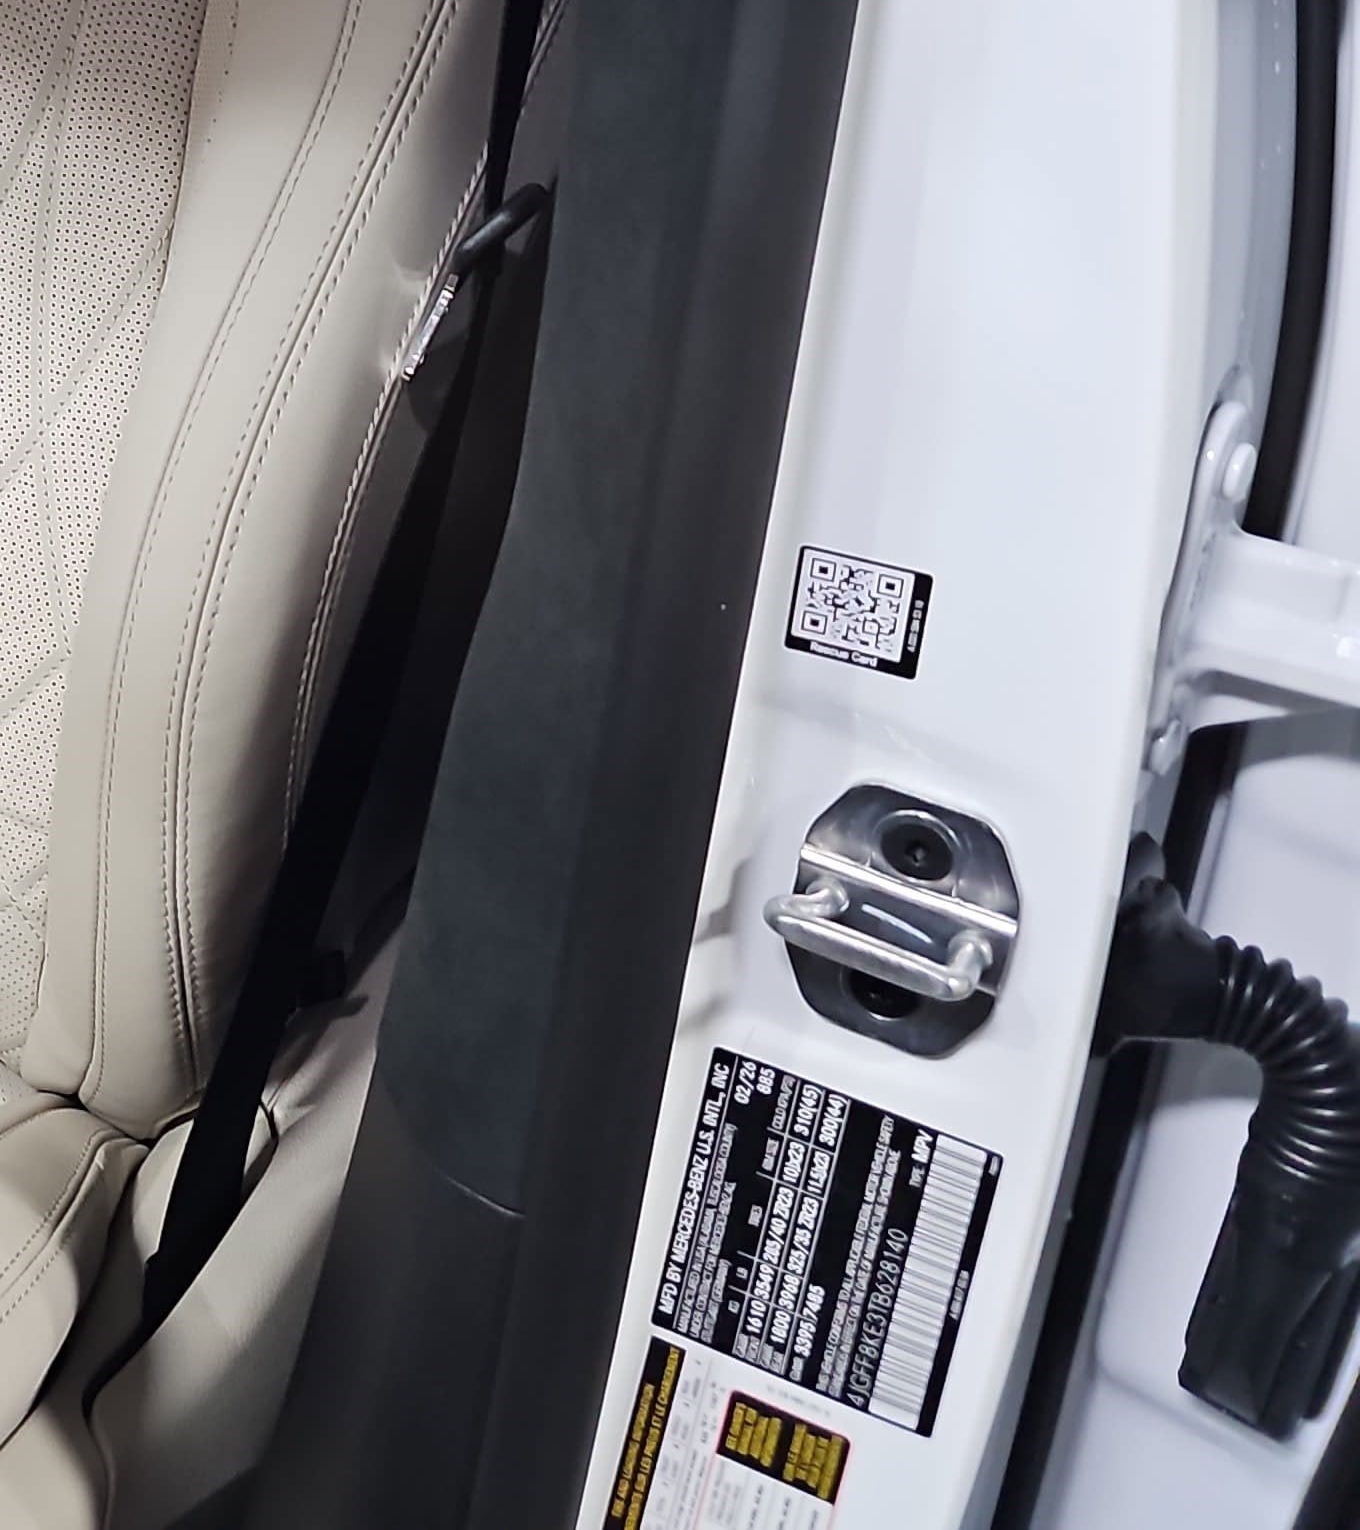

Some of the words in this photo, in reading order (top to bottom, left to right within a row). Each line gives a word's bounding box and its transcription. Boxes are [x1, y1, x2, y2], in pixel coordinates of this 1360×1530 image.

[809, 641, 850, 660] Rescue
[851, 651, 878, 668] Card
[711, 1063, 730, 1089] INC
[734, 1061, 757, 1104] 02/26
[756, 1067, 775, 1095] 885
[793, 1084, 823, 1136] 310(45)
[818, 1094, 848, 1147] 300(44)
[911, 1129, 933, 1164] MPV
[670, 1154, 709, 1263] MERCEDES-BENZ
[787, 1227, 812, 1275] 325/35
[665, 1262, 682, 1283] BY
[753, 1261, 776, 1301] 3549
[778, 1271, 801, 1311] 3968
[658, 1283, 678, 1314] MFD
[746, 1297, 768, 1334] 1610
[794, 1320, 816, 1358] 3395
